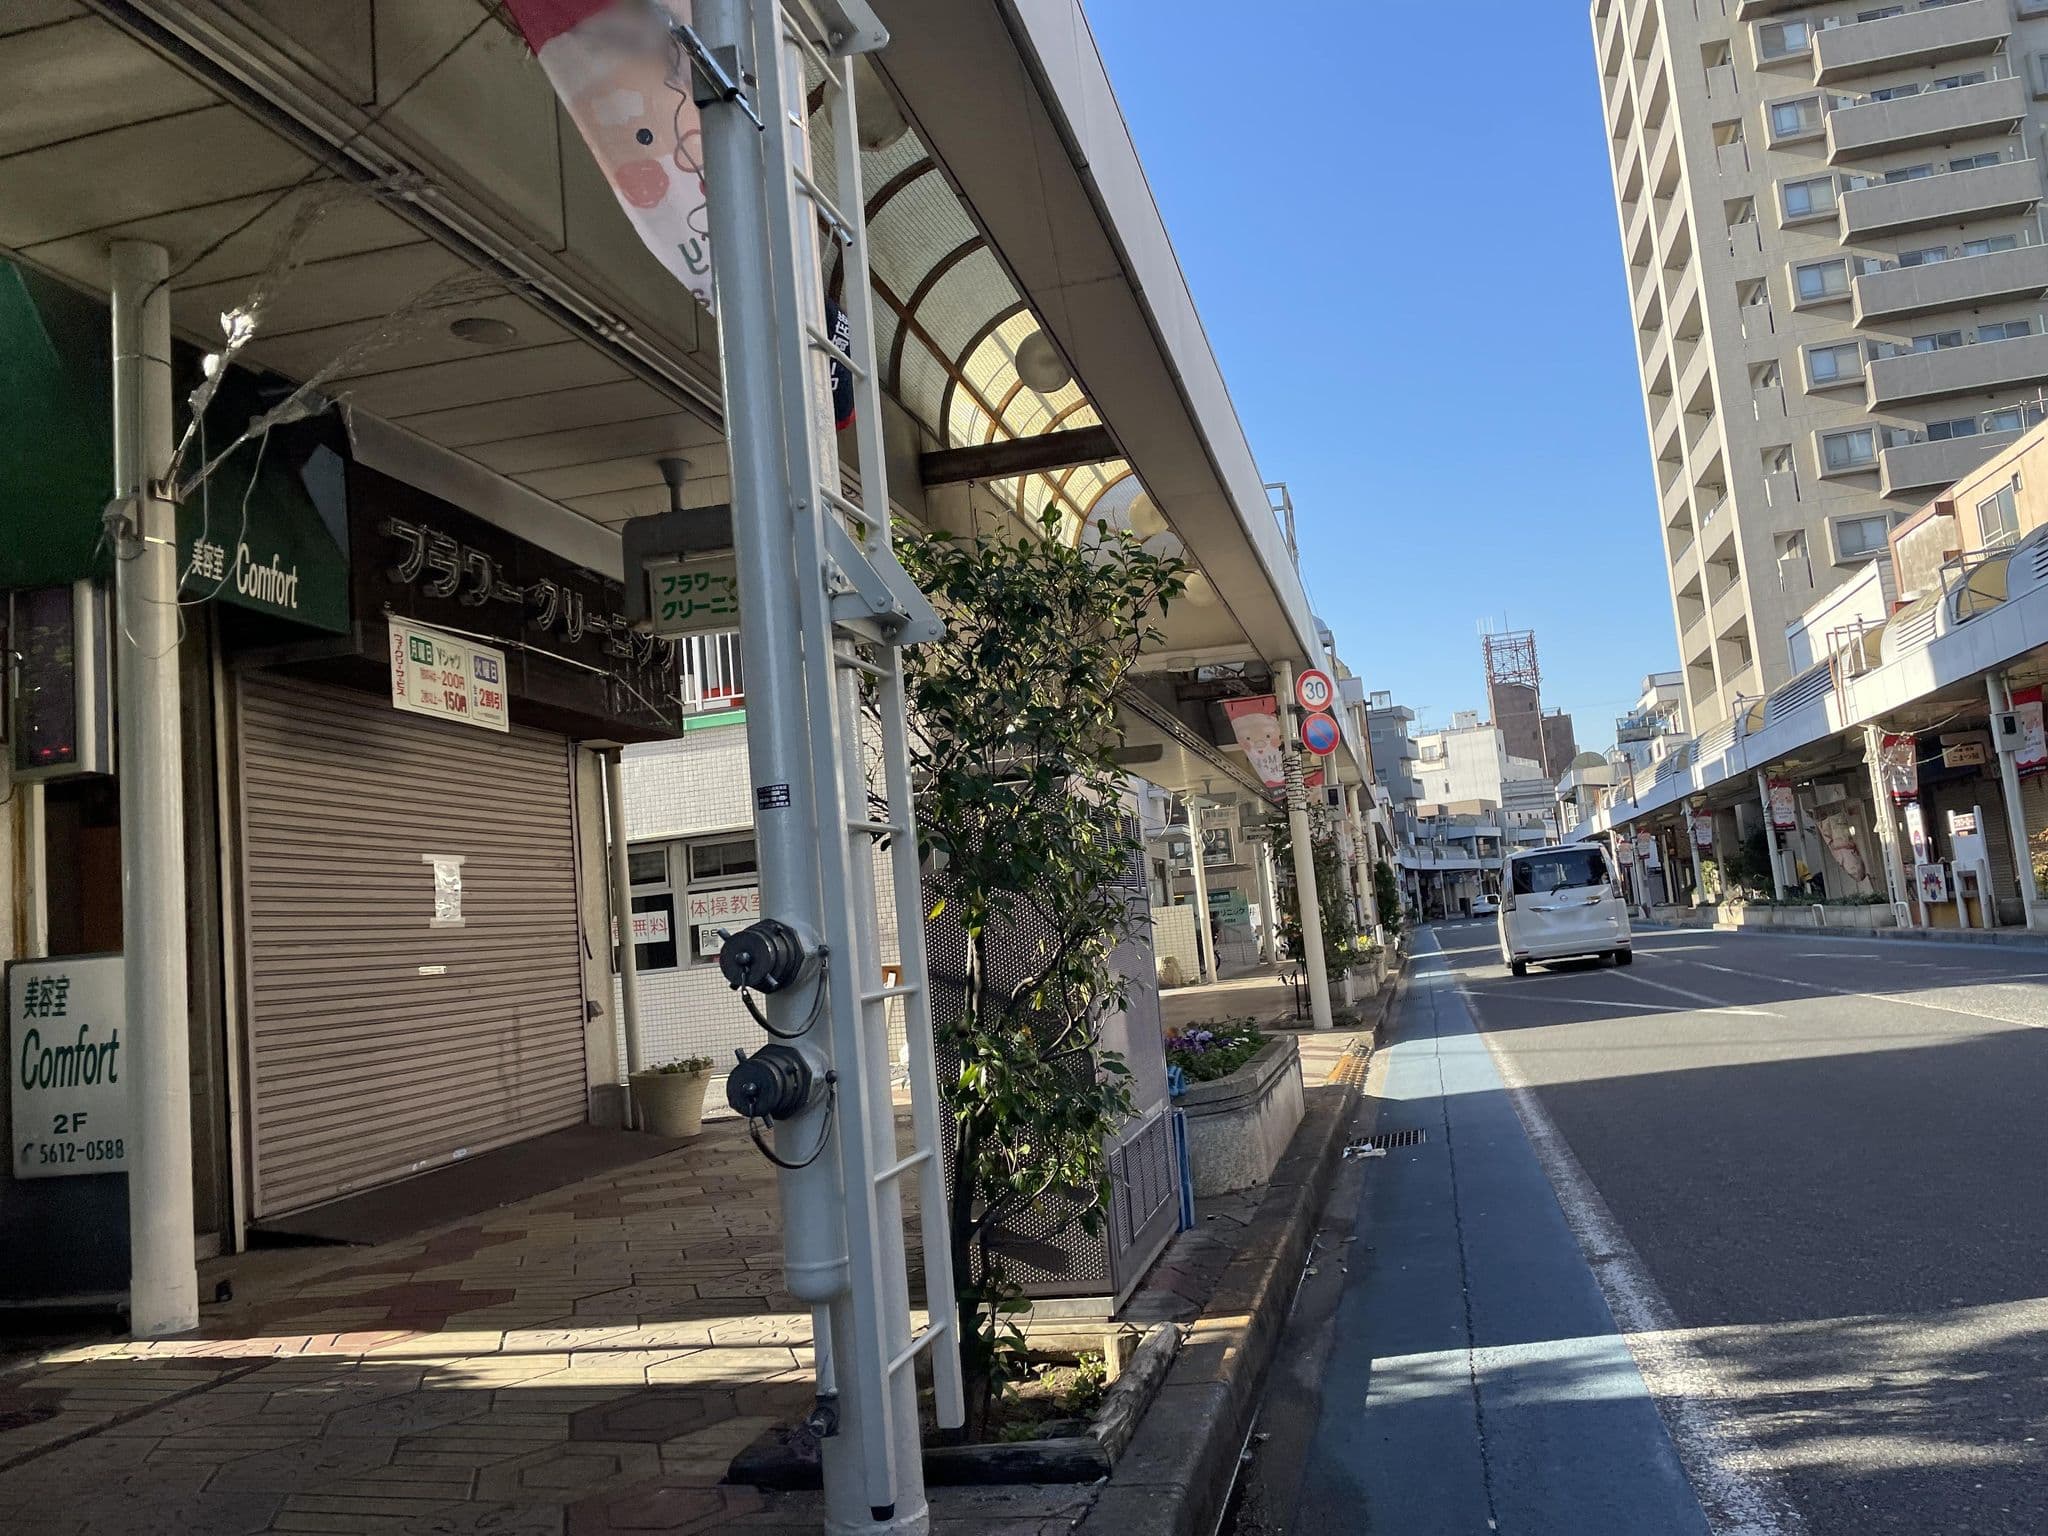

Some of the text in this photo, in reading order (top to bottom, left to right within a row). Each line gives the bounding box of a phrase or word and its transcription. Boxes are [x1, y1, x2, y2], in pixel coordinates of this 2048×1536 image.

[191, 539, 298, 609] 美容室 Comfort
[661, 571, 728, 595] フラワー
[441, 670, 465, 691] 200円
[1305, 681, 1326, 700] 30
[443, 690, 468, 714] 150円
[22, 975, 71, 1019] 美容室
[21, 1023, 120, 1090] Comfort
[53, 1112, 88, 1134] 2F
[40, 1138, 125, 1164] 5612-0588
